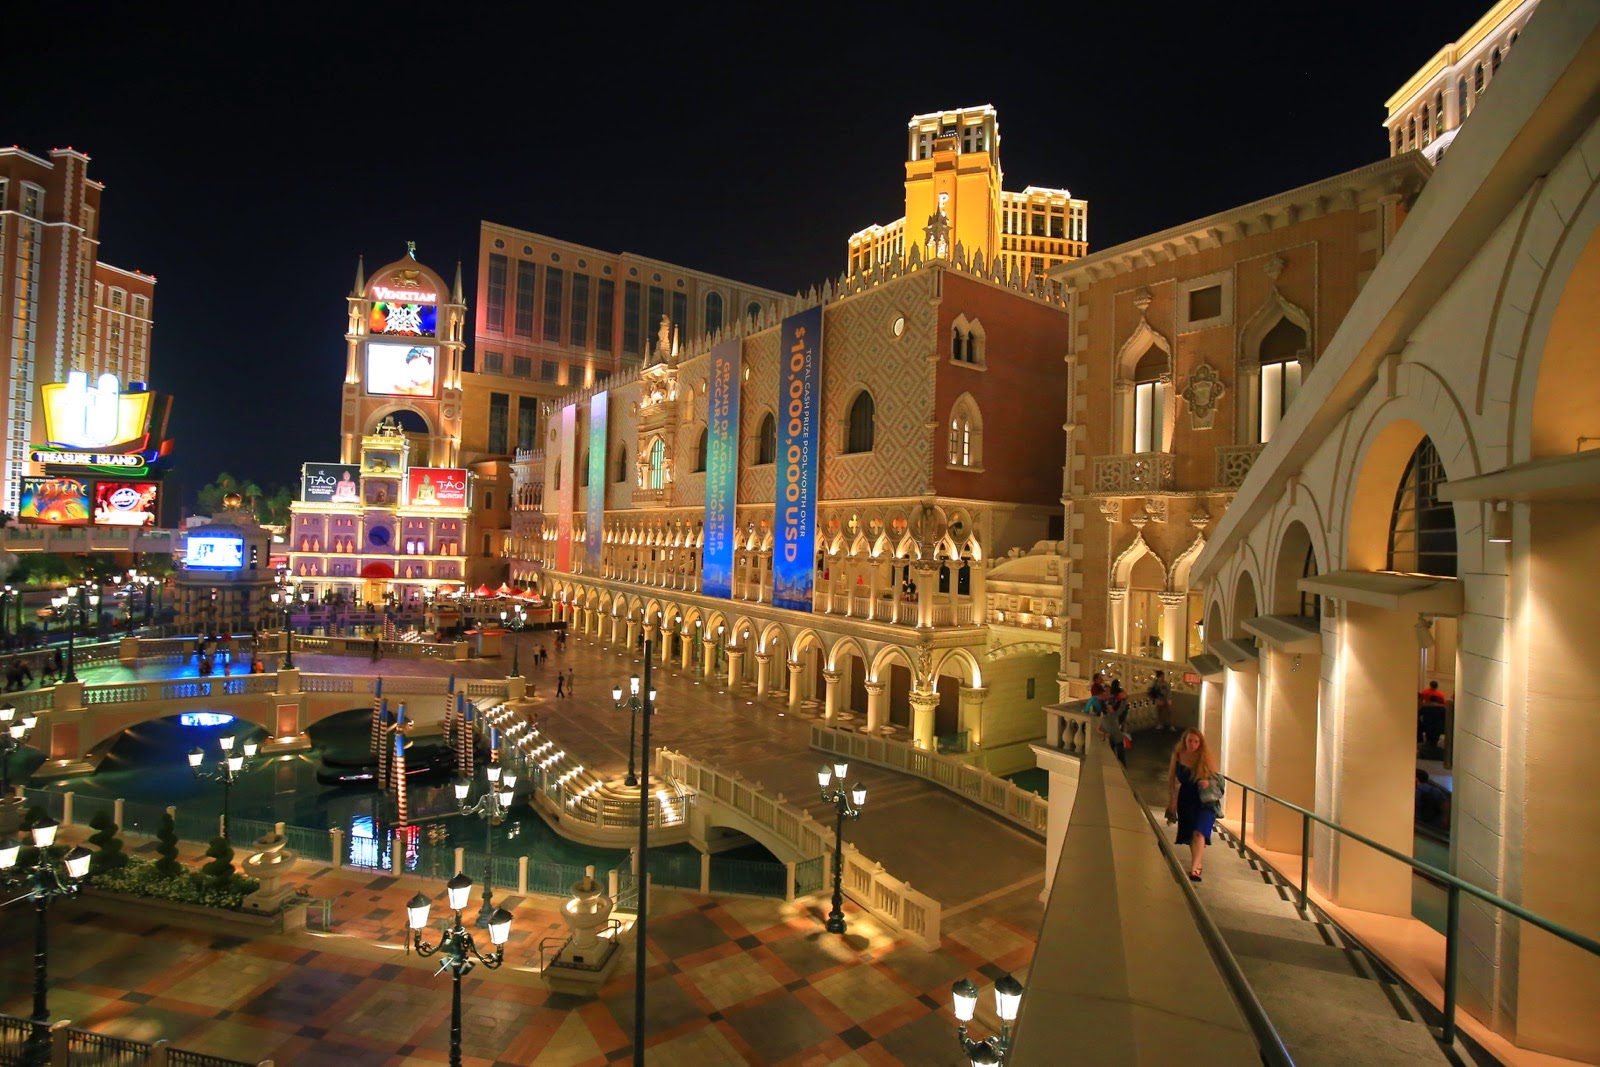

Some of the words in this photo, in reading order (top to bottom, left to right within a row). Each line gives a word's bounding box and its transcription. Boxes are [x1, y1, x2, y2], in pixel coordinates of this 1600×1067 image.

[372, 286, 437, 302] VENETIAN
[721, 361, 731, 416] GRAND
[804, 348, 812, 381] TOTAL
[713, 358, 723, 436] BACCARAT
[786, 326, 806, 502] $10,000,000
[37, 452, 92, 464] TREASURE
[96, 454, 138, 465] ISLAND
[719, 419, 729, 486] DRAGON
[306, 475, 337, 486] TAO
[435, 480, 465, 491] TAO
[709, 439, 720, 556] CHAMPIONSHIP
[716, 490, 725, 550] MASTER
[784, 506, 799, 562] USD
